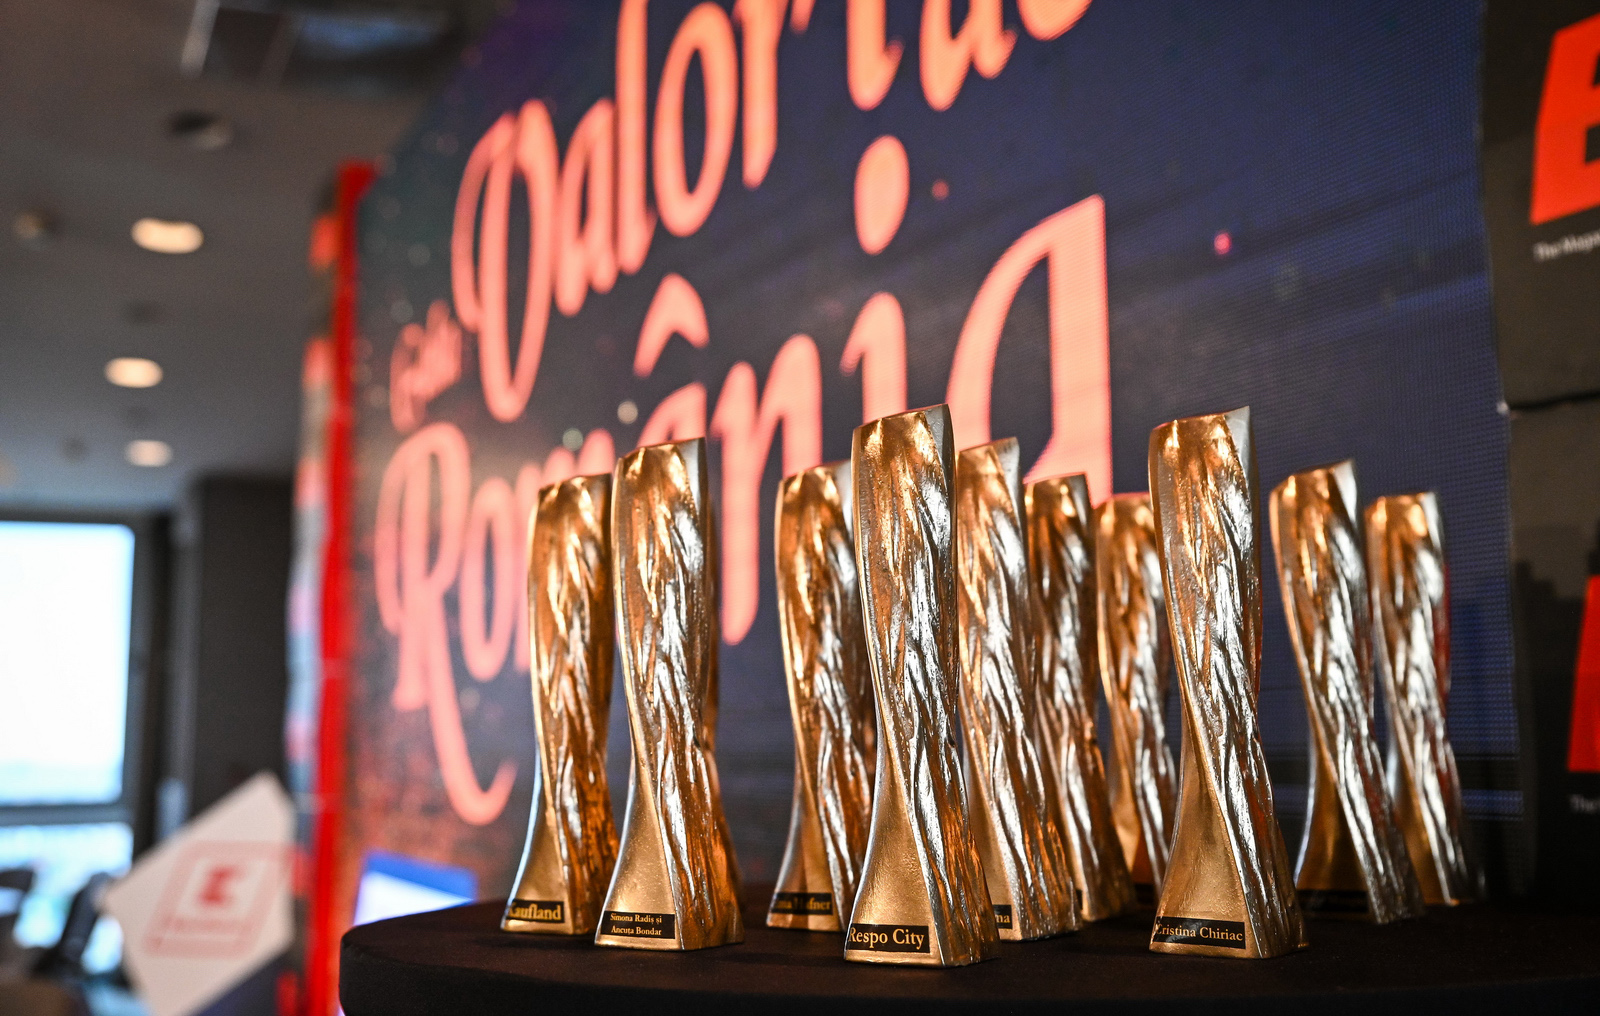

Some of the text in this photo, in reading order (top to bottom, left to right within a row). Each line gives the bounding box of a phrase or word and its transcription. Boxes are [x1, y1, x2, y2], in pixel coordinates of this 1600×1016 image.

[374, 135, 1112, 826] Ronia
[610, 913, 633, 922] Simona
[635, 926, 663, 936] Bondar
[1199, 926, 1243, 941] Chiriac
[848, 928, 925, 950] Respo City
